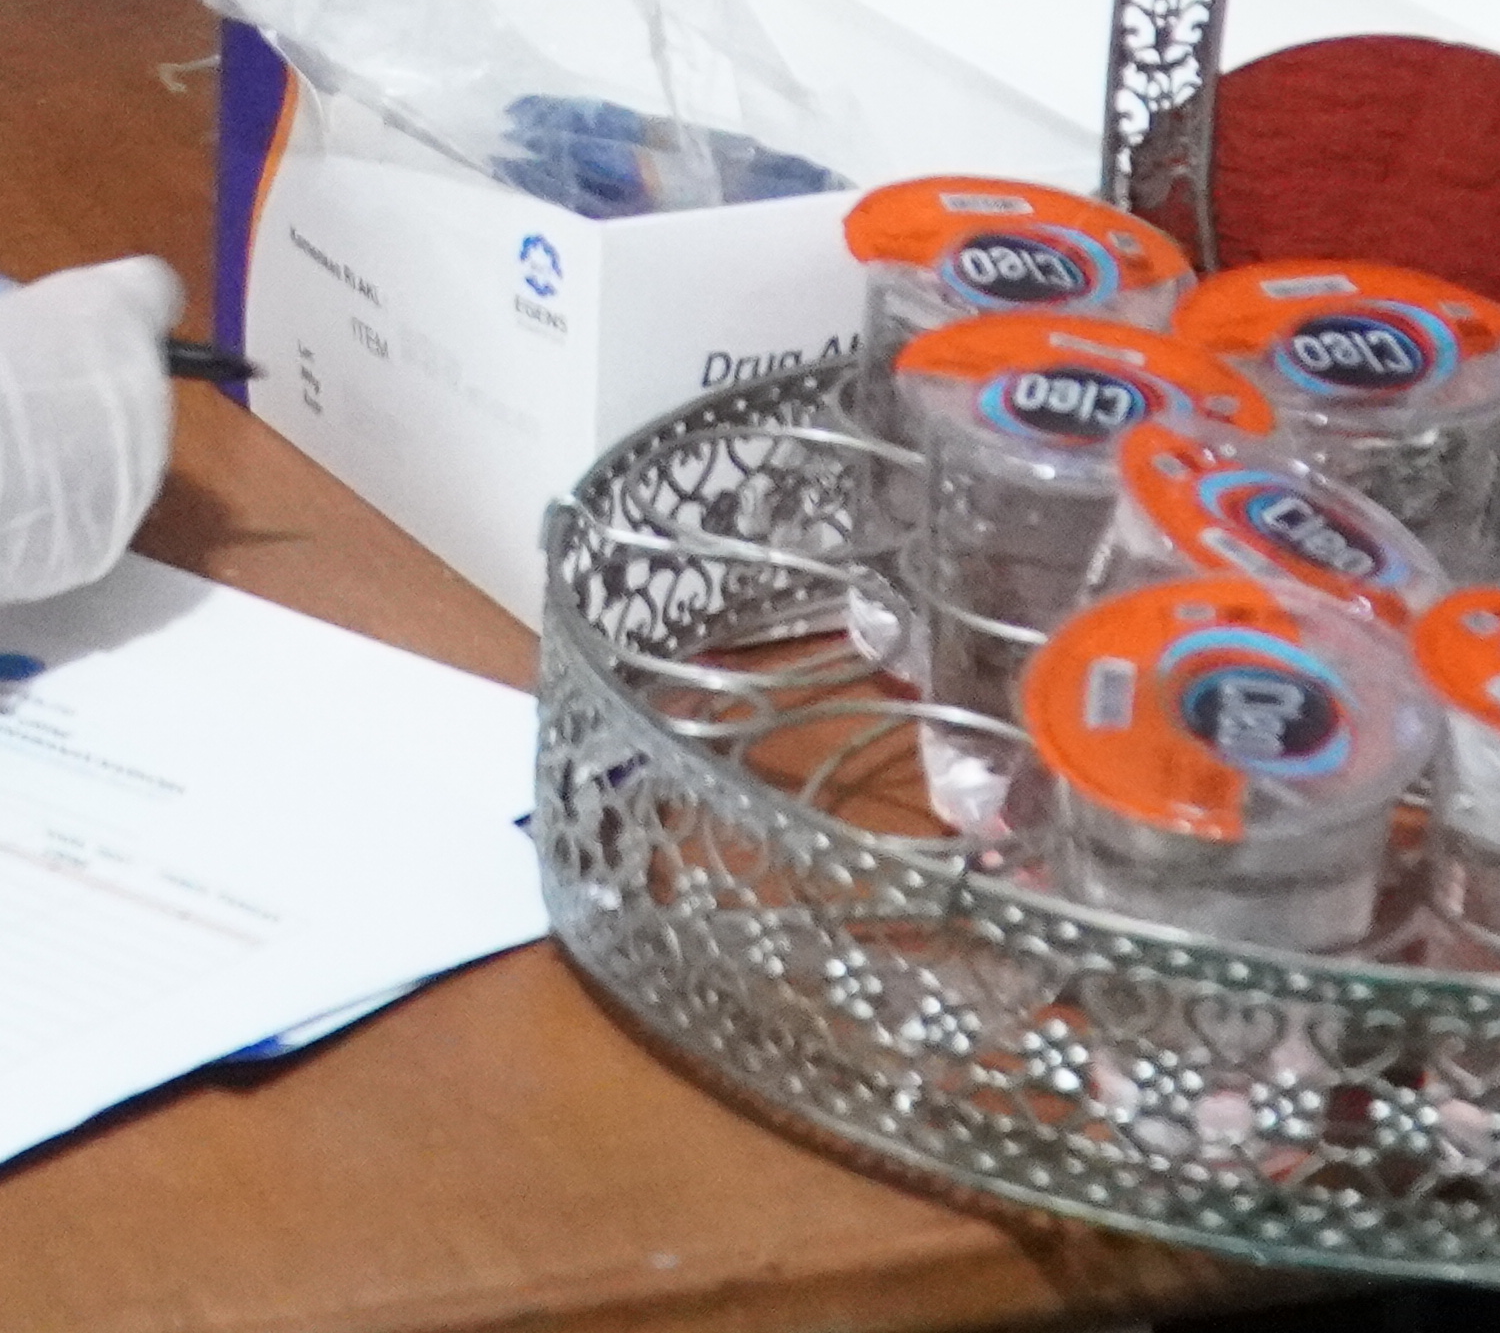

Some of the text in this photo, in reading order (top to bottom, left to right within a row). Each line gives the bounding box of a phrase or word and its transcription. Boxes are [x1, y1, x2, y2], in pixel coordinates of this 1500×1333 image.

[960, 245, 1082, 290] Cleo
[1293, 329, 1415, 375] Cleo
[1015, 372, 1133, 426] Cleo
